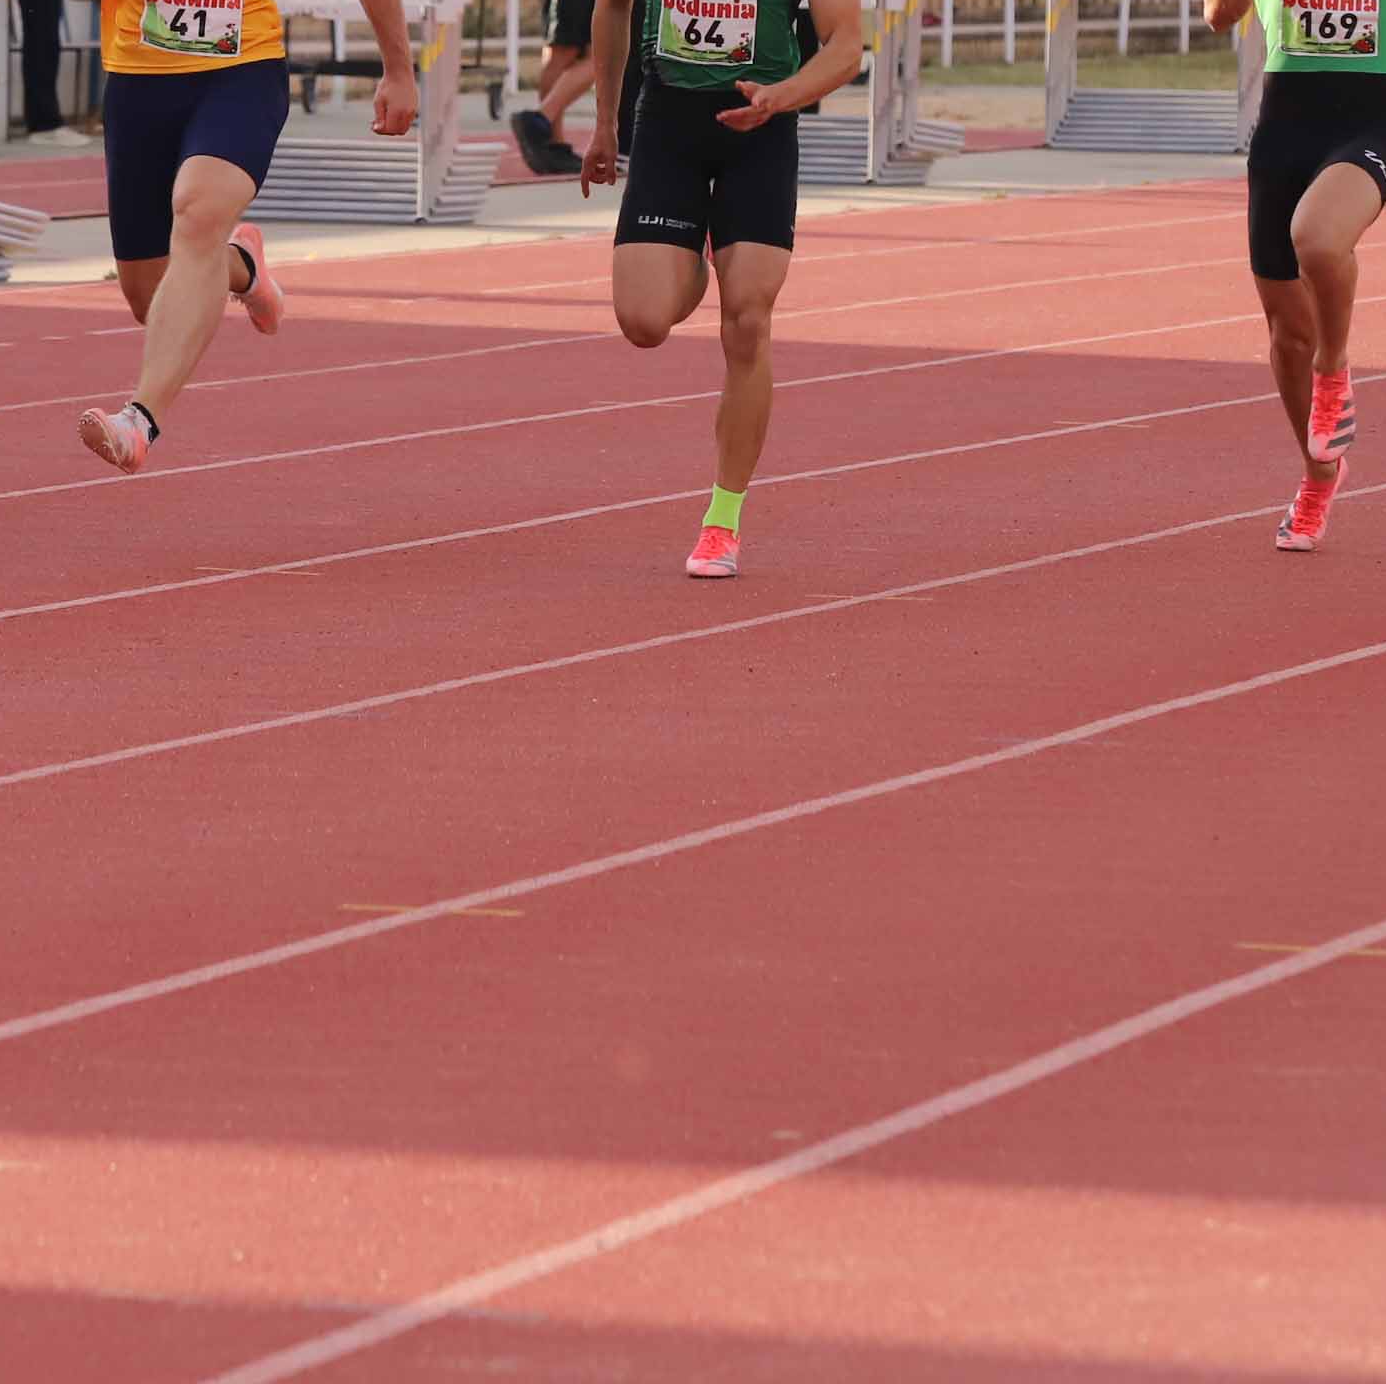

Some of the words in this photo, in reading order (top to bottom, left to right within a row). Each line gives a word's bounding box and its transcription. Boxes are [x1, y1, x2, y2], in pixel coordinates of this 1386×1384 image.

[169, 9, 207, 38] 41
[684, 18, 725, 48] 64
[1299, 11, 1358, 39] 169
